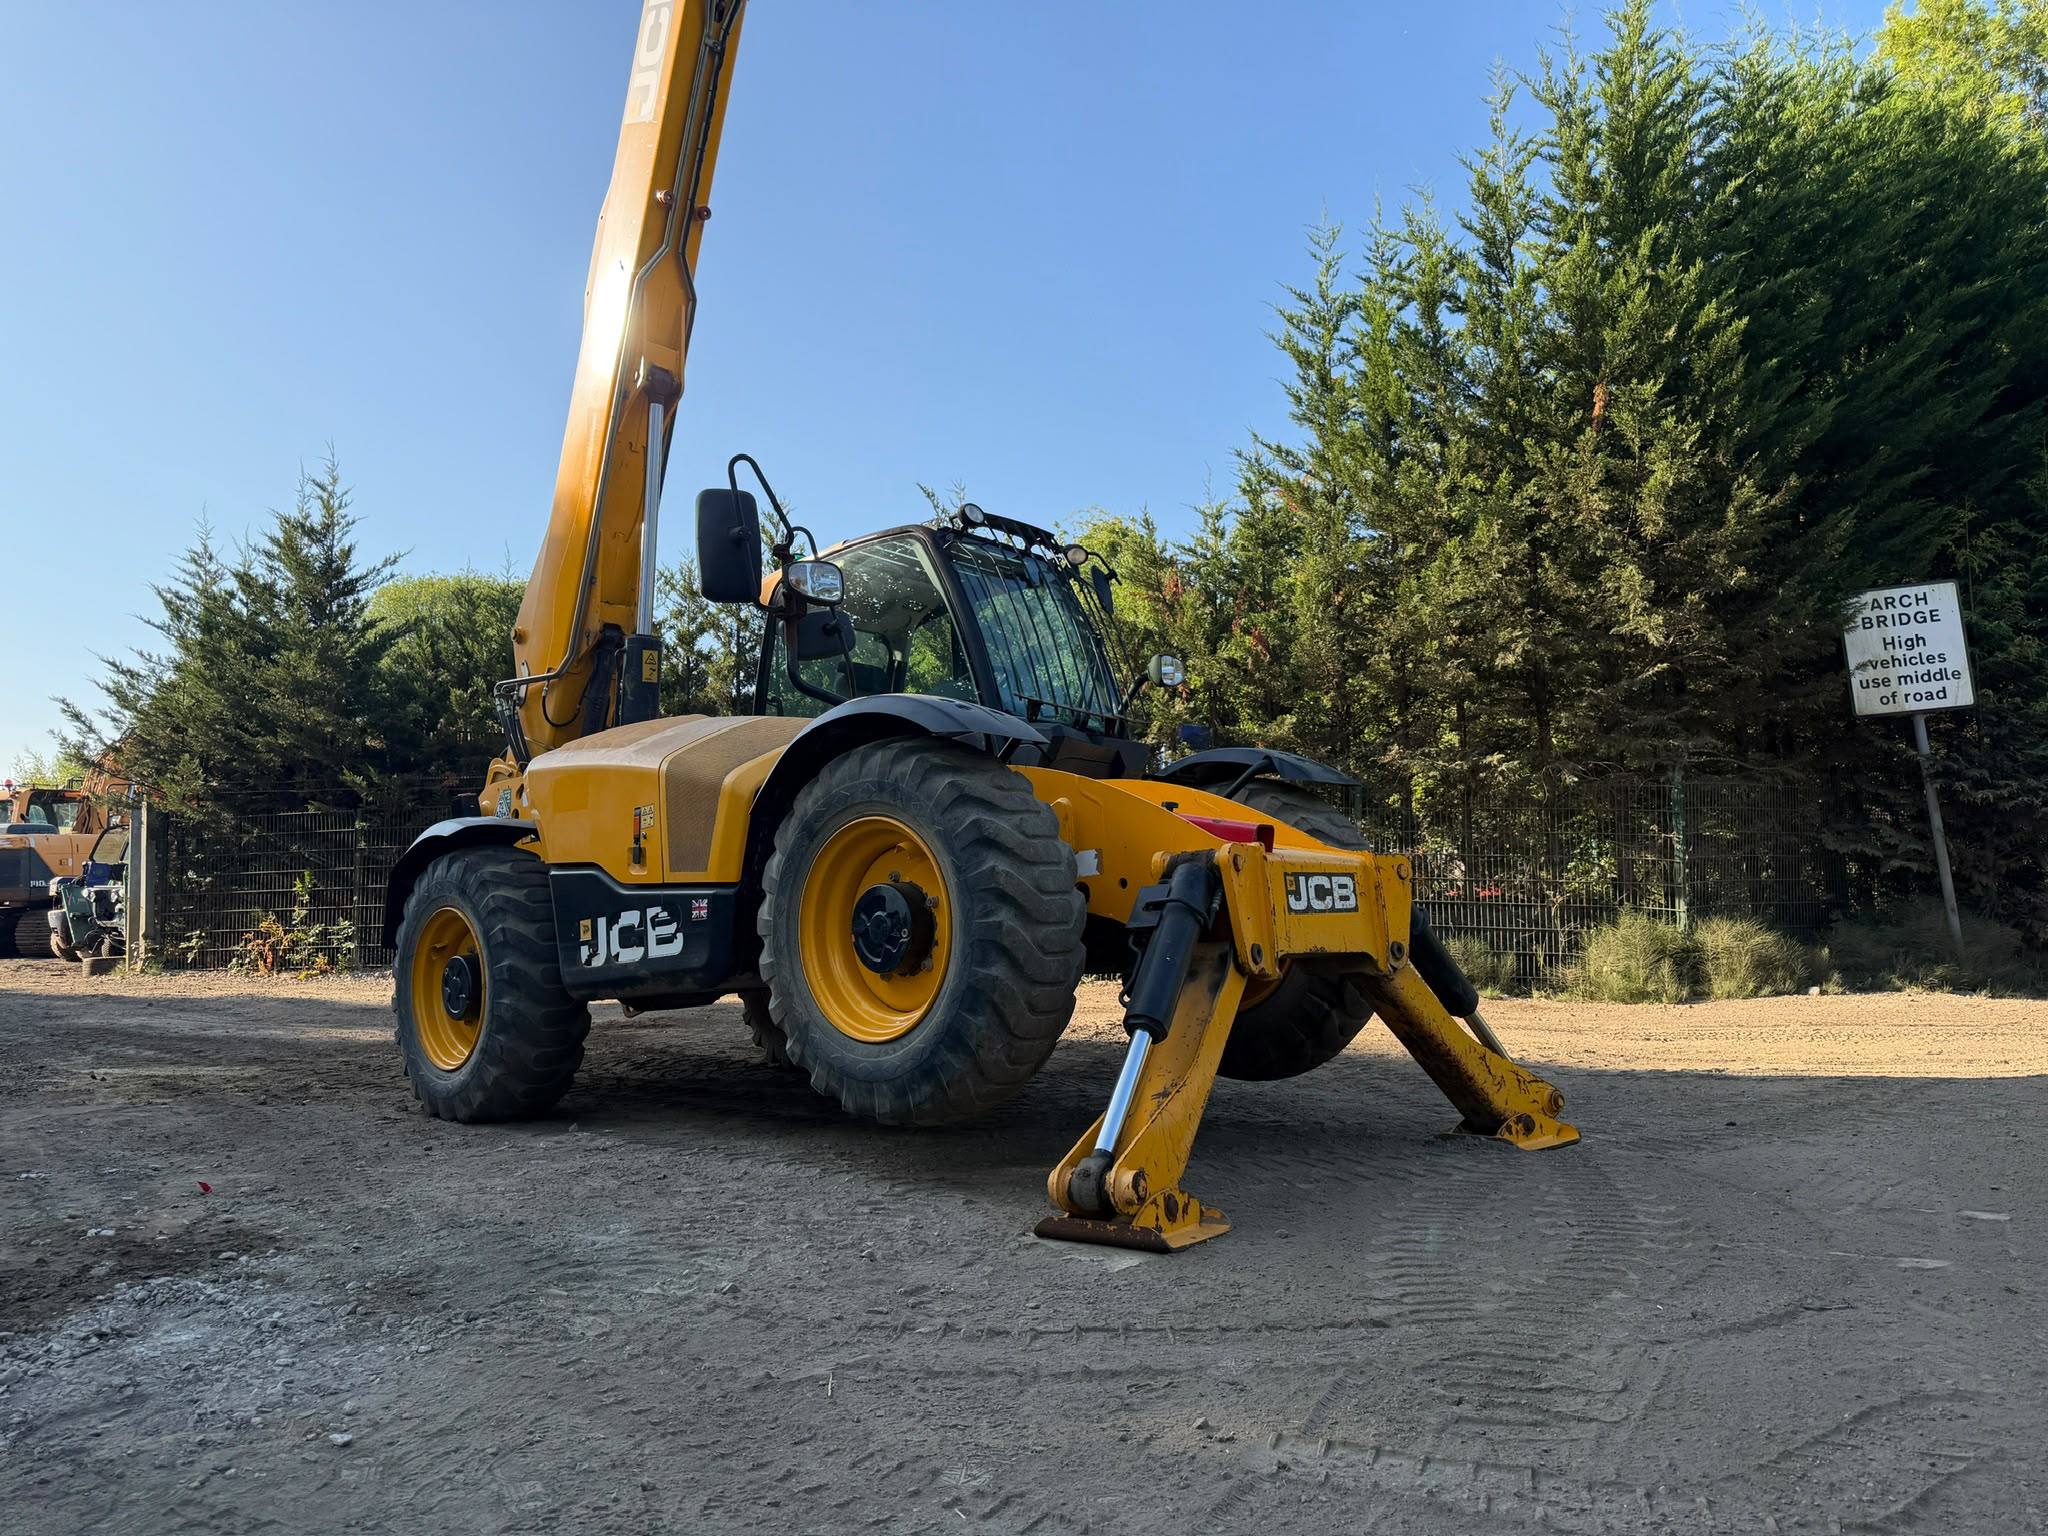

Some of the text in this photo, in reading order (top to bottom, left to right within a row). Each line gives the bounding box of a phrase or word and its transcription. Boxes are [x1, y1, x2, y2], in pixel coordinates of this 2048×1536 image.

[633, 0, 674, 118] JC
[1870, 592, 1928, 611] ARCH
[1861, 609, 1941, 630] BRIDGE
[1882, 633, 1927, 651] High
[1870, 652, 1947, 670] vehicles
[1859, 668, 1962, 689] use middle
[1879, 686, 1948, 706] of road
[1288, 875, 1358, 911] JCB
